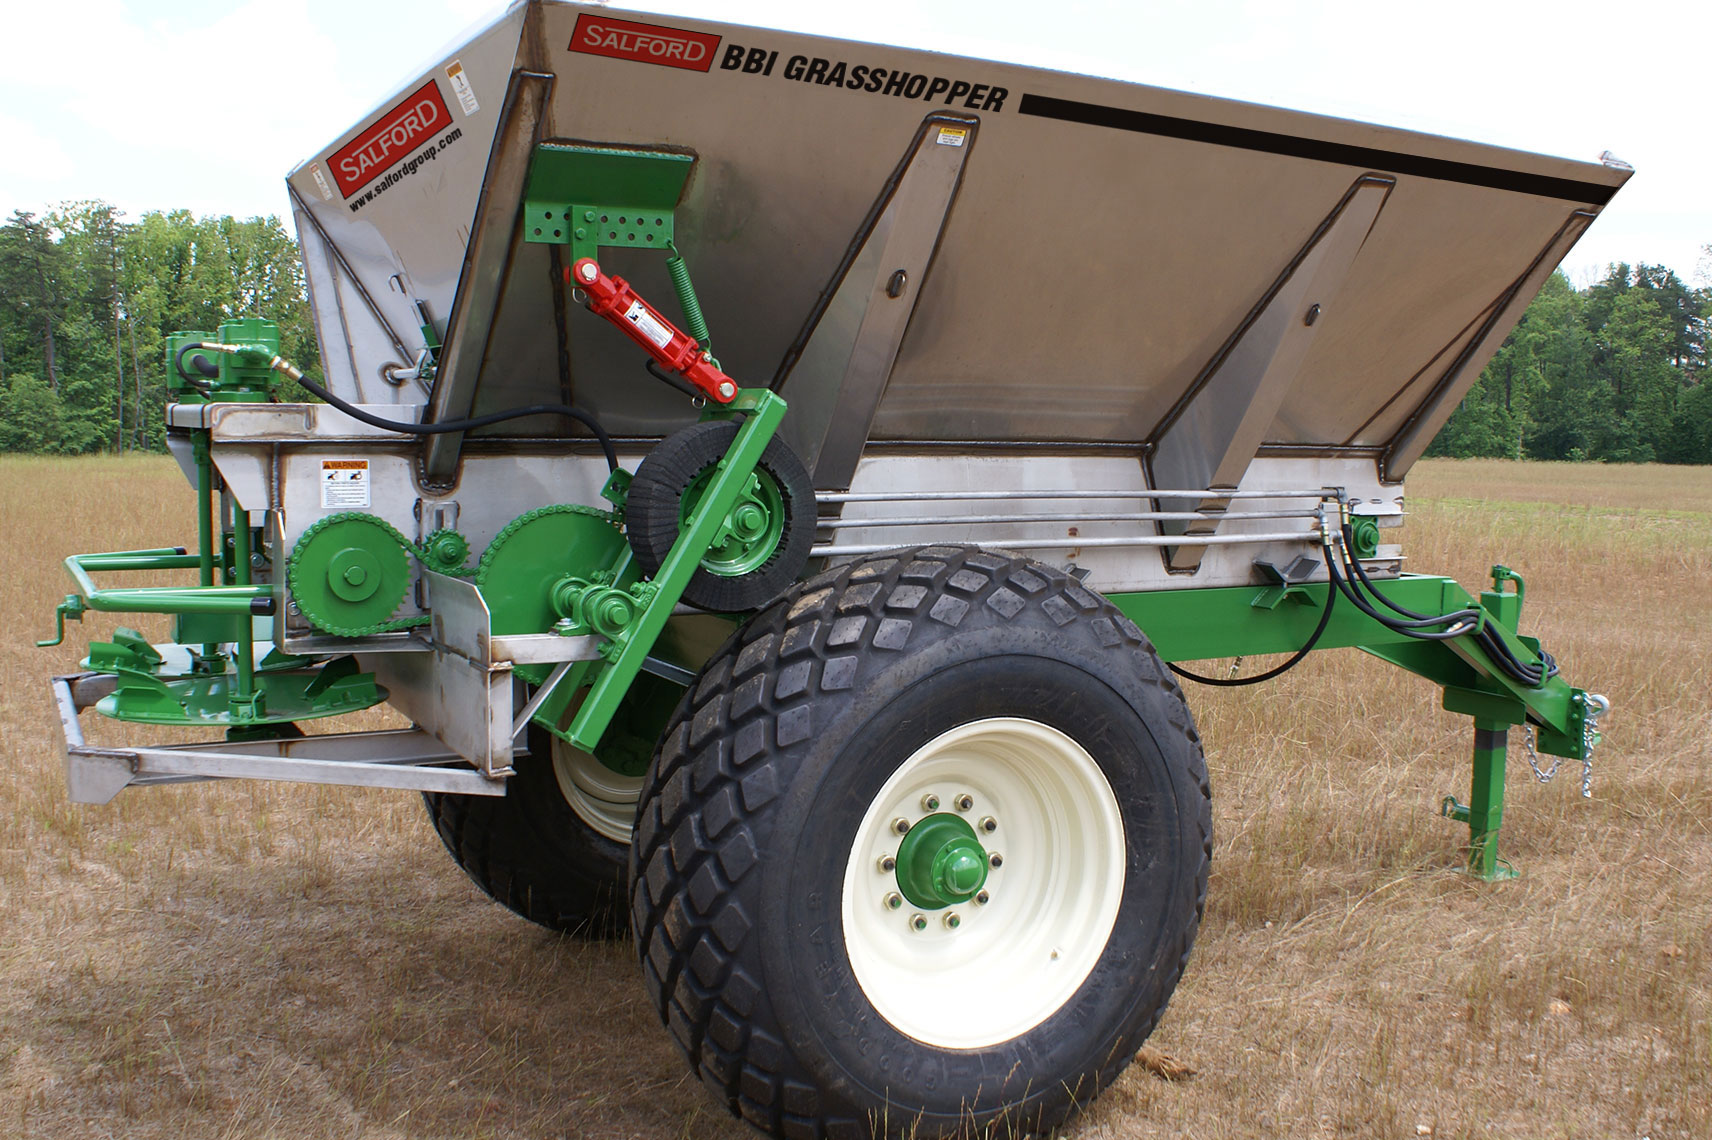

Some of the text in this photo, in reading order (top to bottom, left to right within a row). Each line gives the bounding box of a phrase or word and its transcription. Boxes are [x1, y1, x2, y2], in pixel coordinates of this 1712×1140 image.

[583, 24, 706, 63] SALFORD
[720, 44, 1009, 113] BBI GRASSHOPPER
[340, 99, 438, 182] SALFORD
[349, 127, 463, 212] www.salfordgroup.com
[331, 461, 366, 469] WARNING
